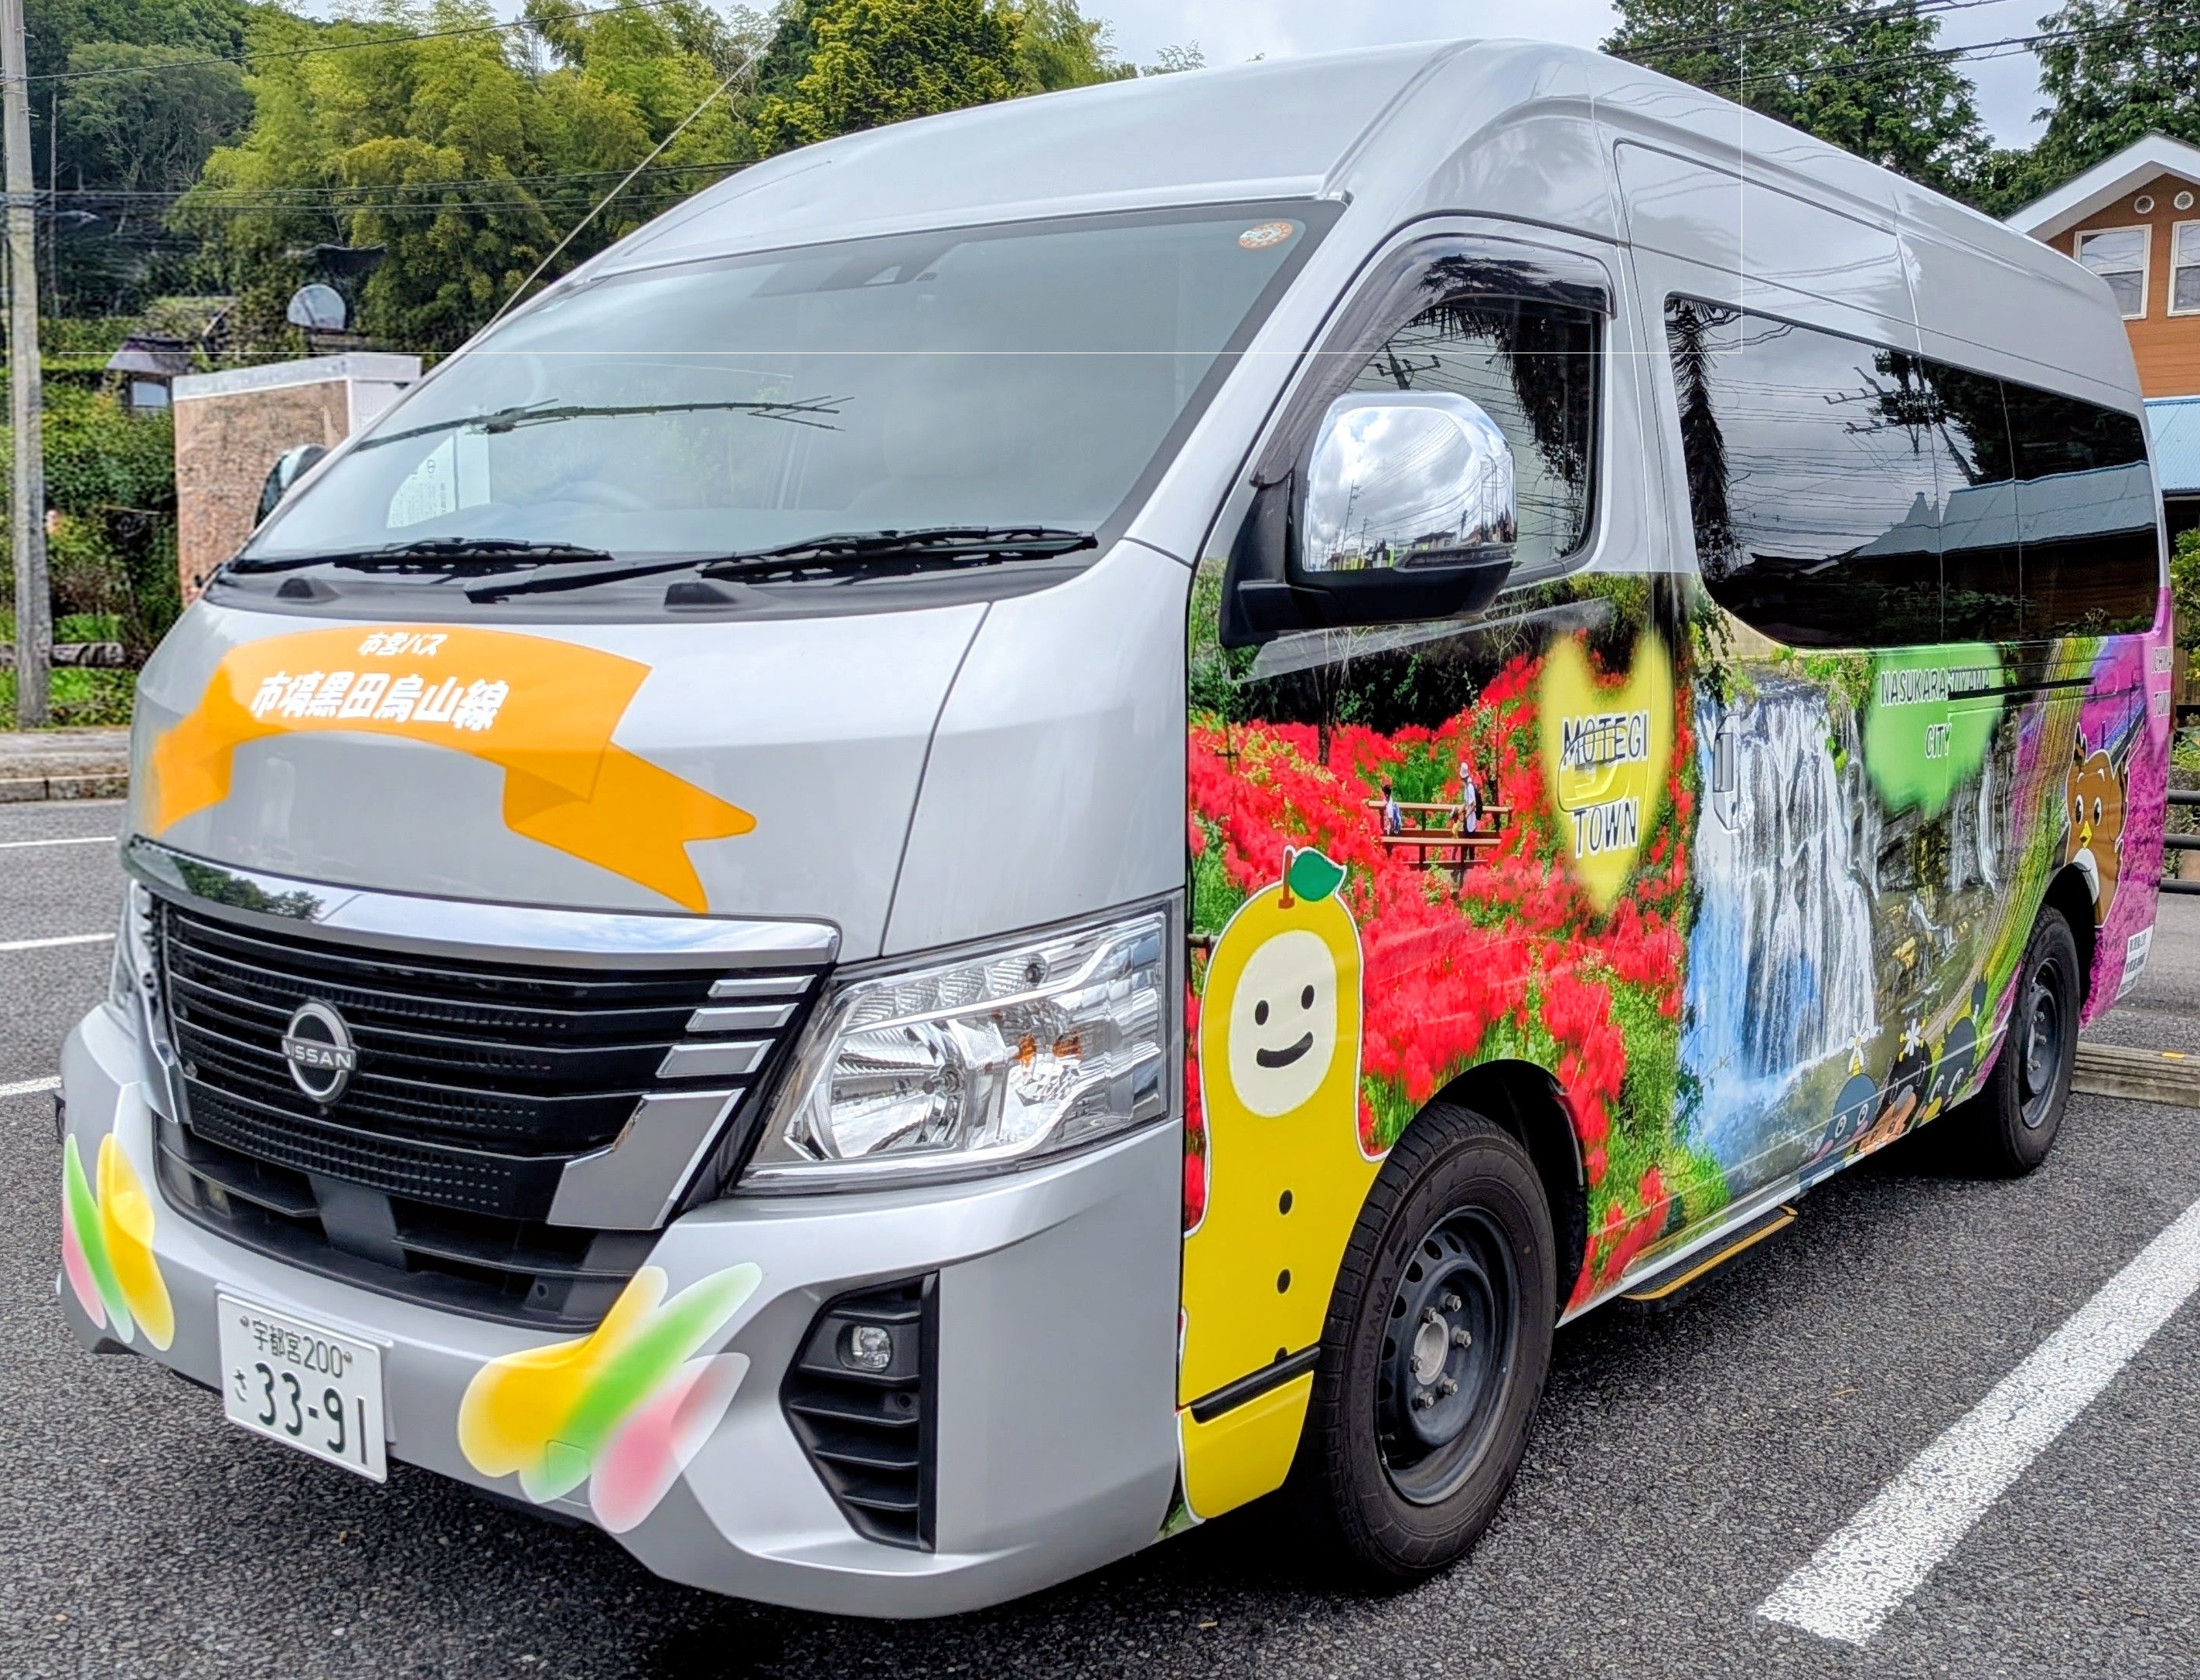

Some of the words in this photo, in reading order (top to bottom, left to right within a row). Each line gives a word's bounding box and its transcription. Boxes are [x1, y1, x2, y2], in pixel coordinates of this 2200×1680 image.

[358, 632, 448, 656] 市営バス
[1562, 712, 1648, 767] MOTEGI
[1925, 723, 1952, 758] CITY
[1574, 798, 1639, 854] TOWN
[281, 1040, 352, 1068] NISSAN
[234, 1368, 248, 1402] さ
[255, 1362, 367, 1465] 33-91
